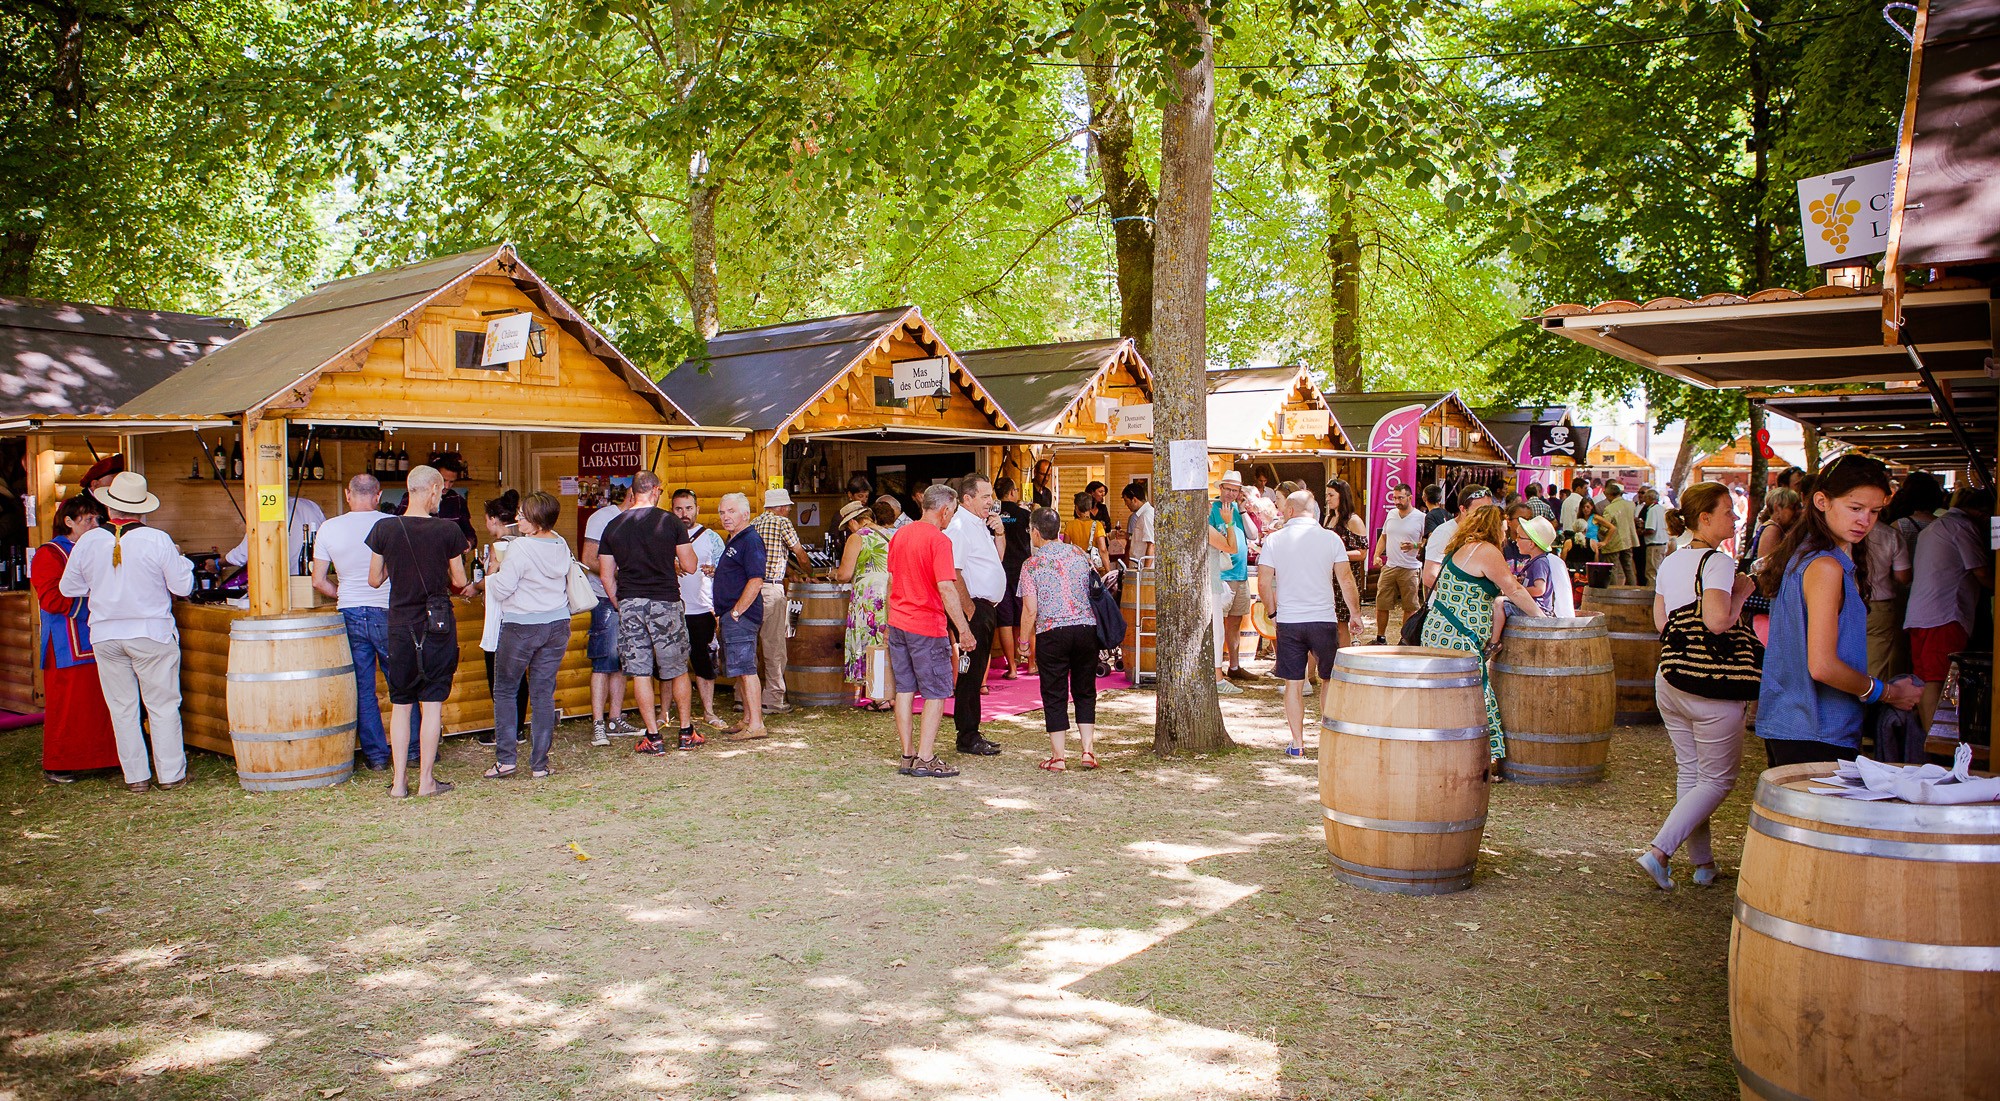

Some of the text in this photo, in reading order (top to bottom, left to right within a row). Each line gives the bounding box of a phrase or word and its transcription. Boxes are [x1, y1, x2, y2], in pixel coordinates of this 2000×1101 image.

[913, 368, 928, 378] Mas
[900, 379, 942, 391] des Combes
[591, 442, 639, 453] CHATEAU
[262, 494, 277, 506] 29
